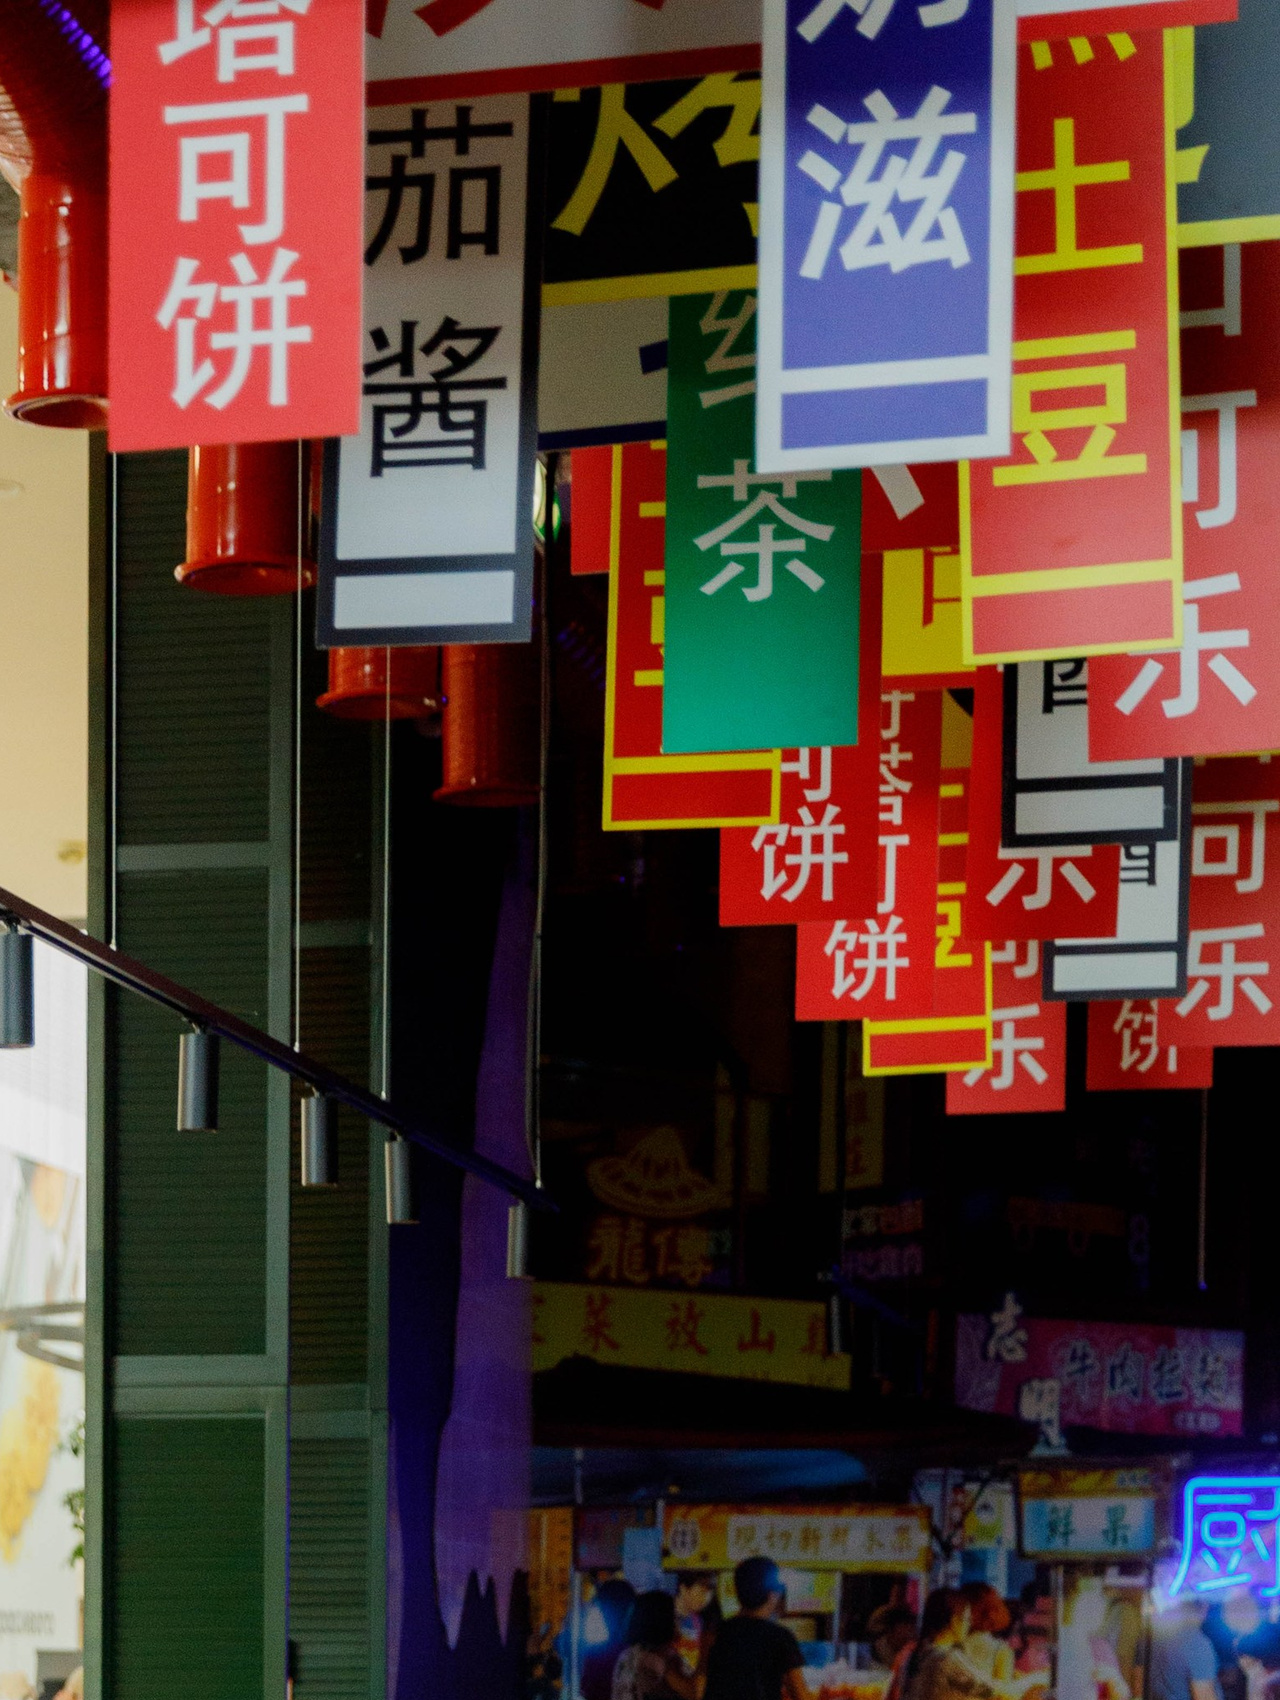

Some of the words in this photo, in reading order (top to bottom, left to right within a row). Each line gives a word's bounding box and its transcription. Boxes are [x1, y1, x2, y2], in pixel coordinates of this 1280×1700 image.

[362, 104, 515, 478] 茄酱
[795, 0, 979, 281] 滋
[992, 32, 1148, 487] 土豆
[1174, 756, 1280, 1021] 可乐
